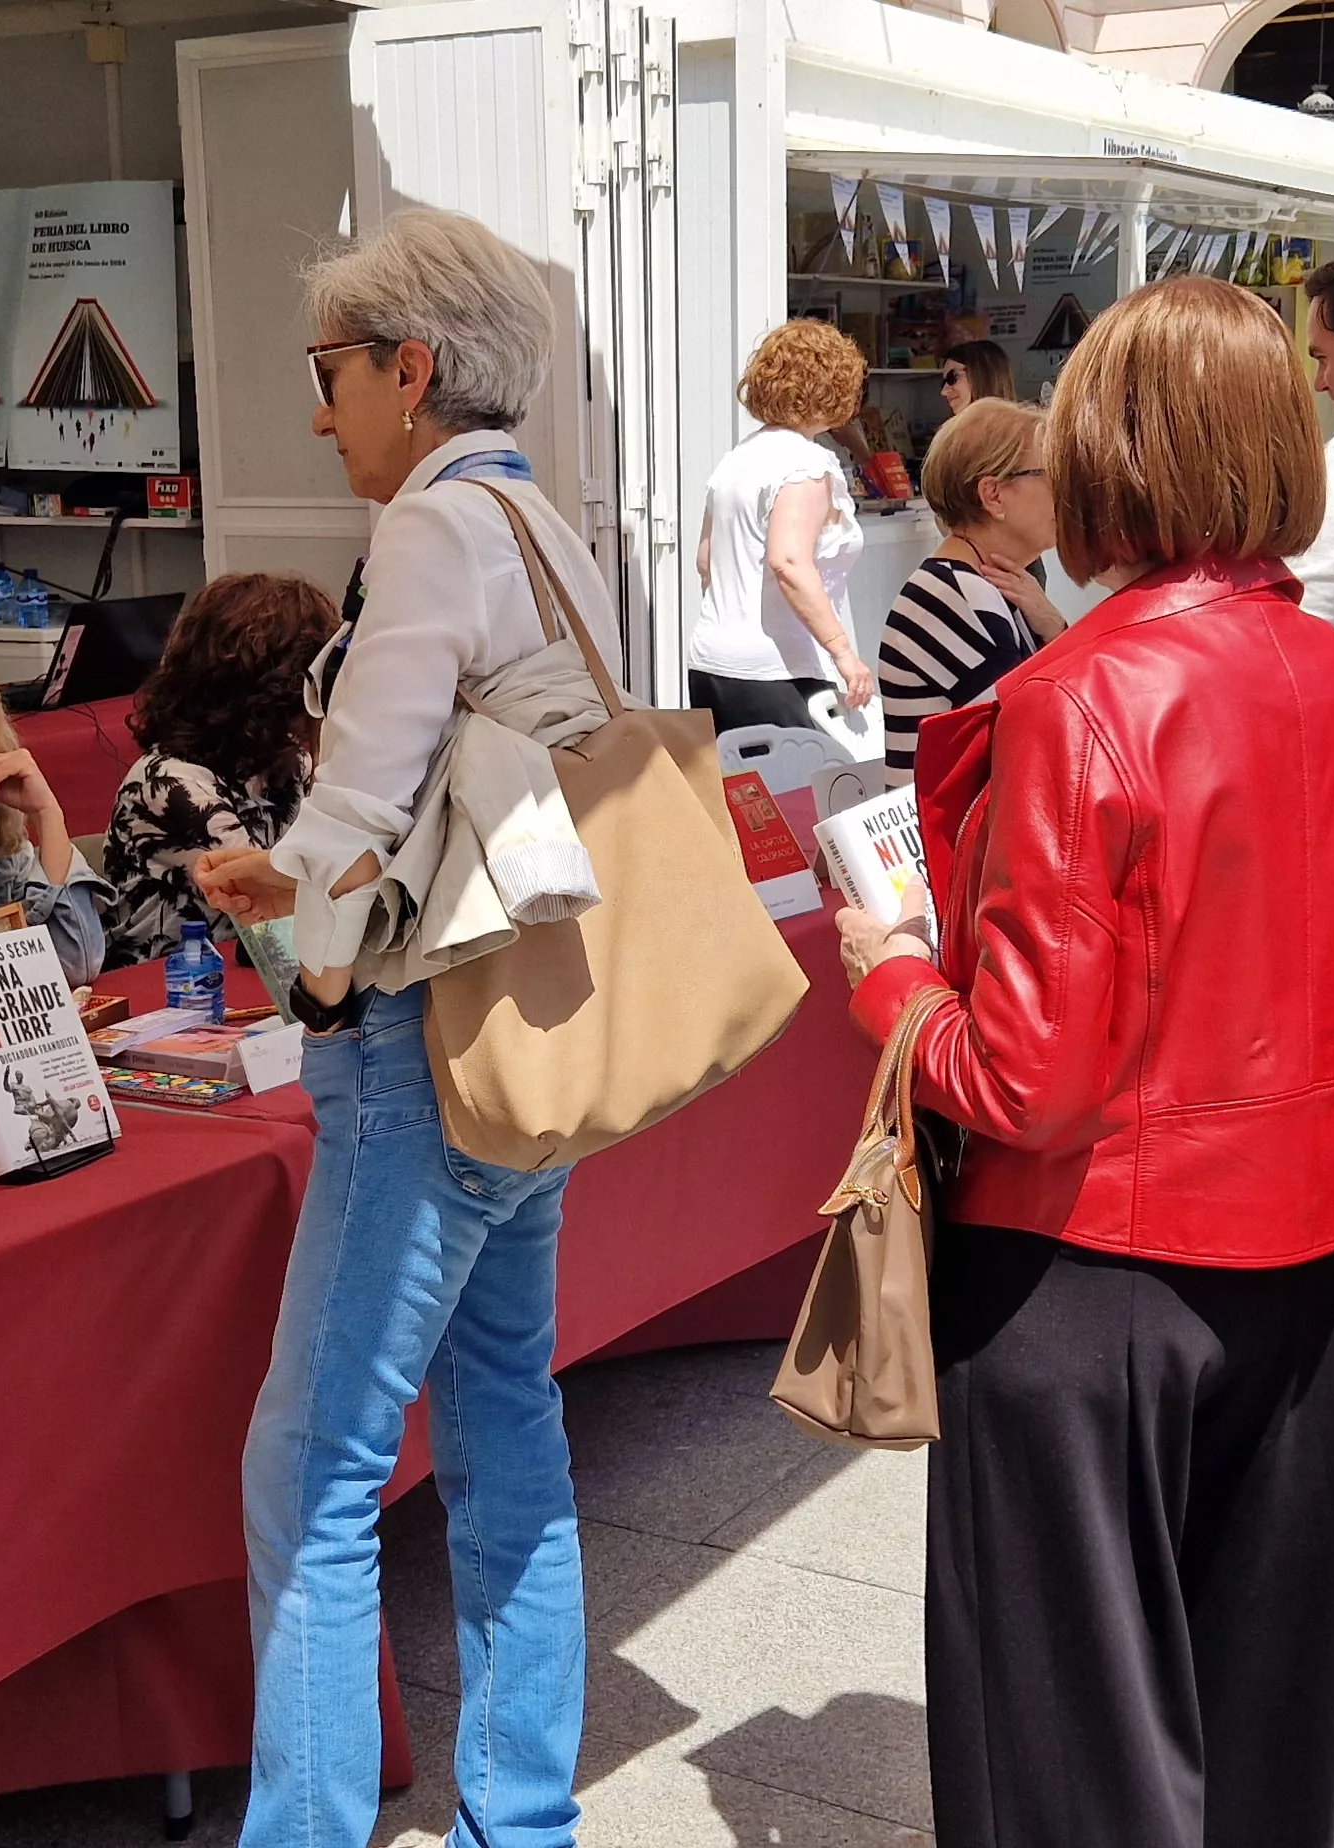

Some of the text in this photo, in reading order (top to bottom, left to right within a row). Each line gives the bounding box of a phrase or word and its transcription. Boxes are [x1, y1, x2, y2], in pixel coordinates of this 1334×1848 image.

[33, 222, 130, 238] FERIA DEL LIBRO
[32, 240, 91, 254] DE HUESCA
[862, 796, 918, 838] NICOLÁ
[827, 838, 844, 866] LIBRE
[873, 834, 904, 872] NI
[6, 938, 46, 959] SESMA
[1, 1012, 55, 1046] LIBRE
